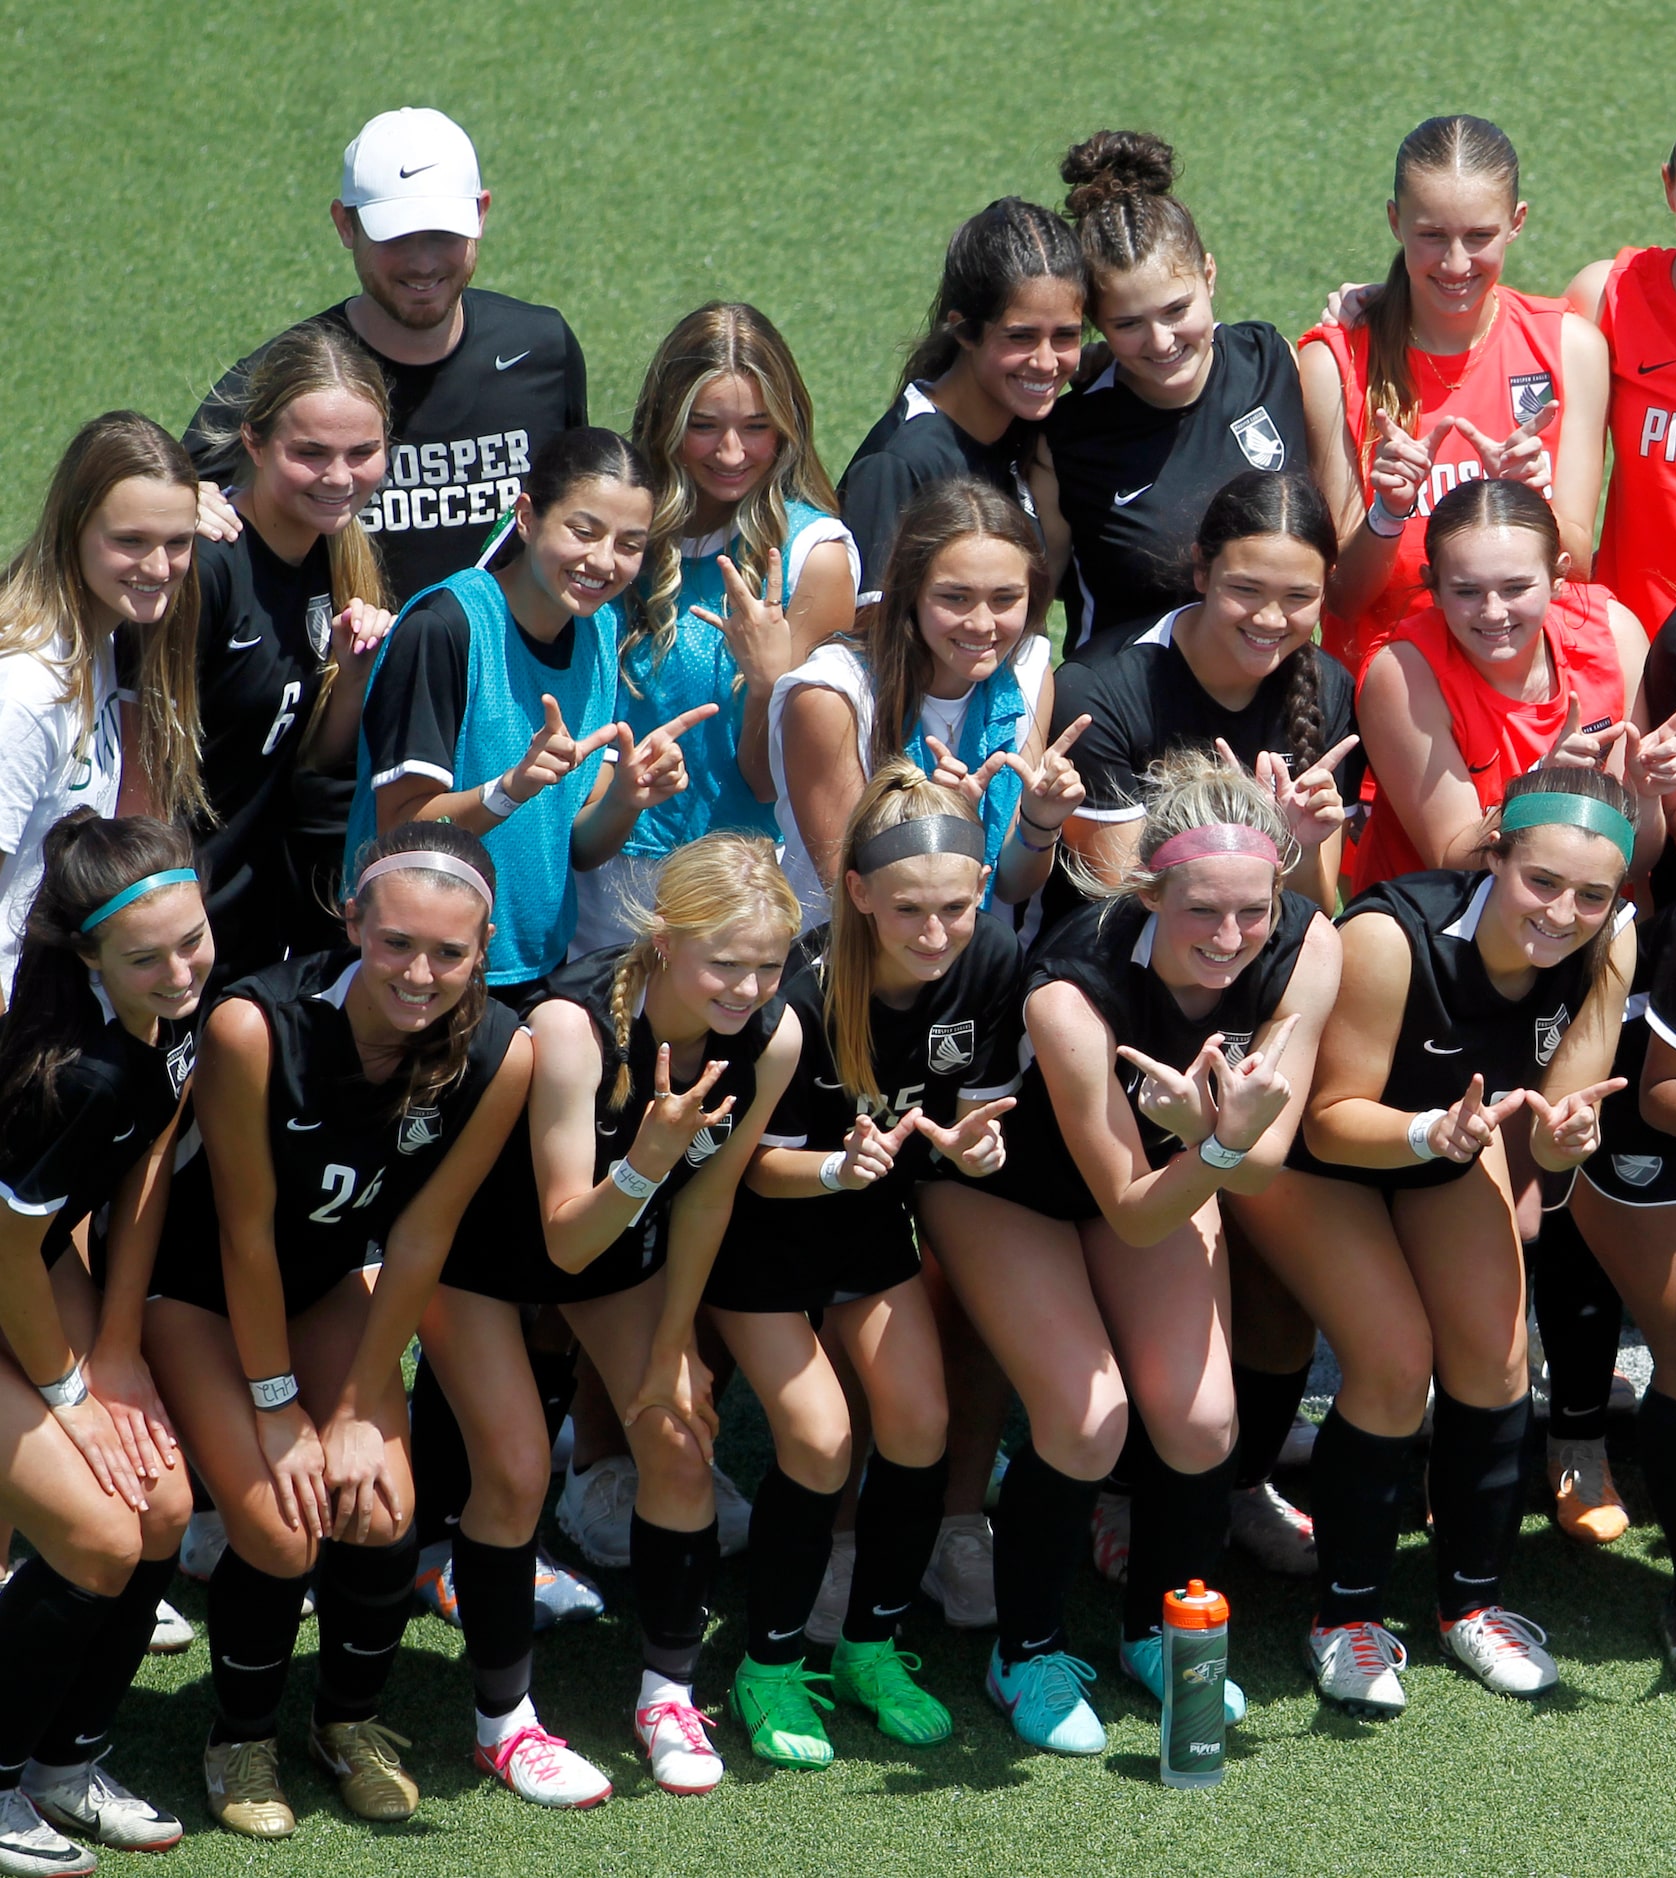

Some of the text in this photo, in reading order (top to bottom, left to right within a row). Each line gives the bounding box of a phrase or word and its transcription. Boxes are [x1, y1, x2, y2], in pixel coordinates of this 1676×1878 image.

[381, 430, 530, 488] OSPER
[262, 681, 301, 755] 6
[620, 1167, 647, 1193] 442
